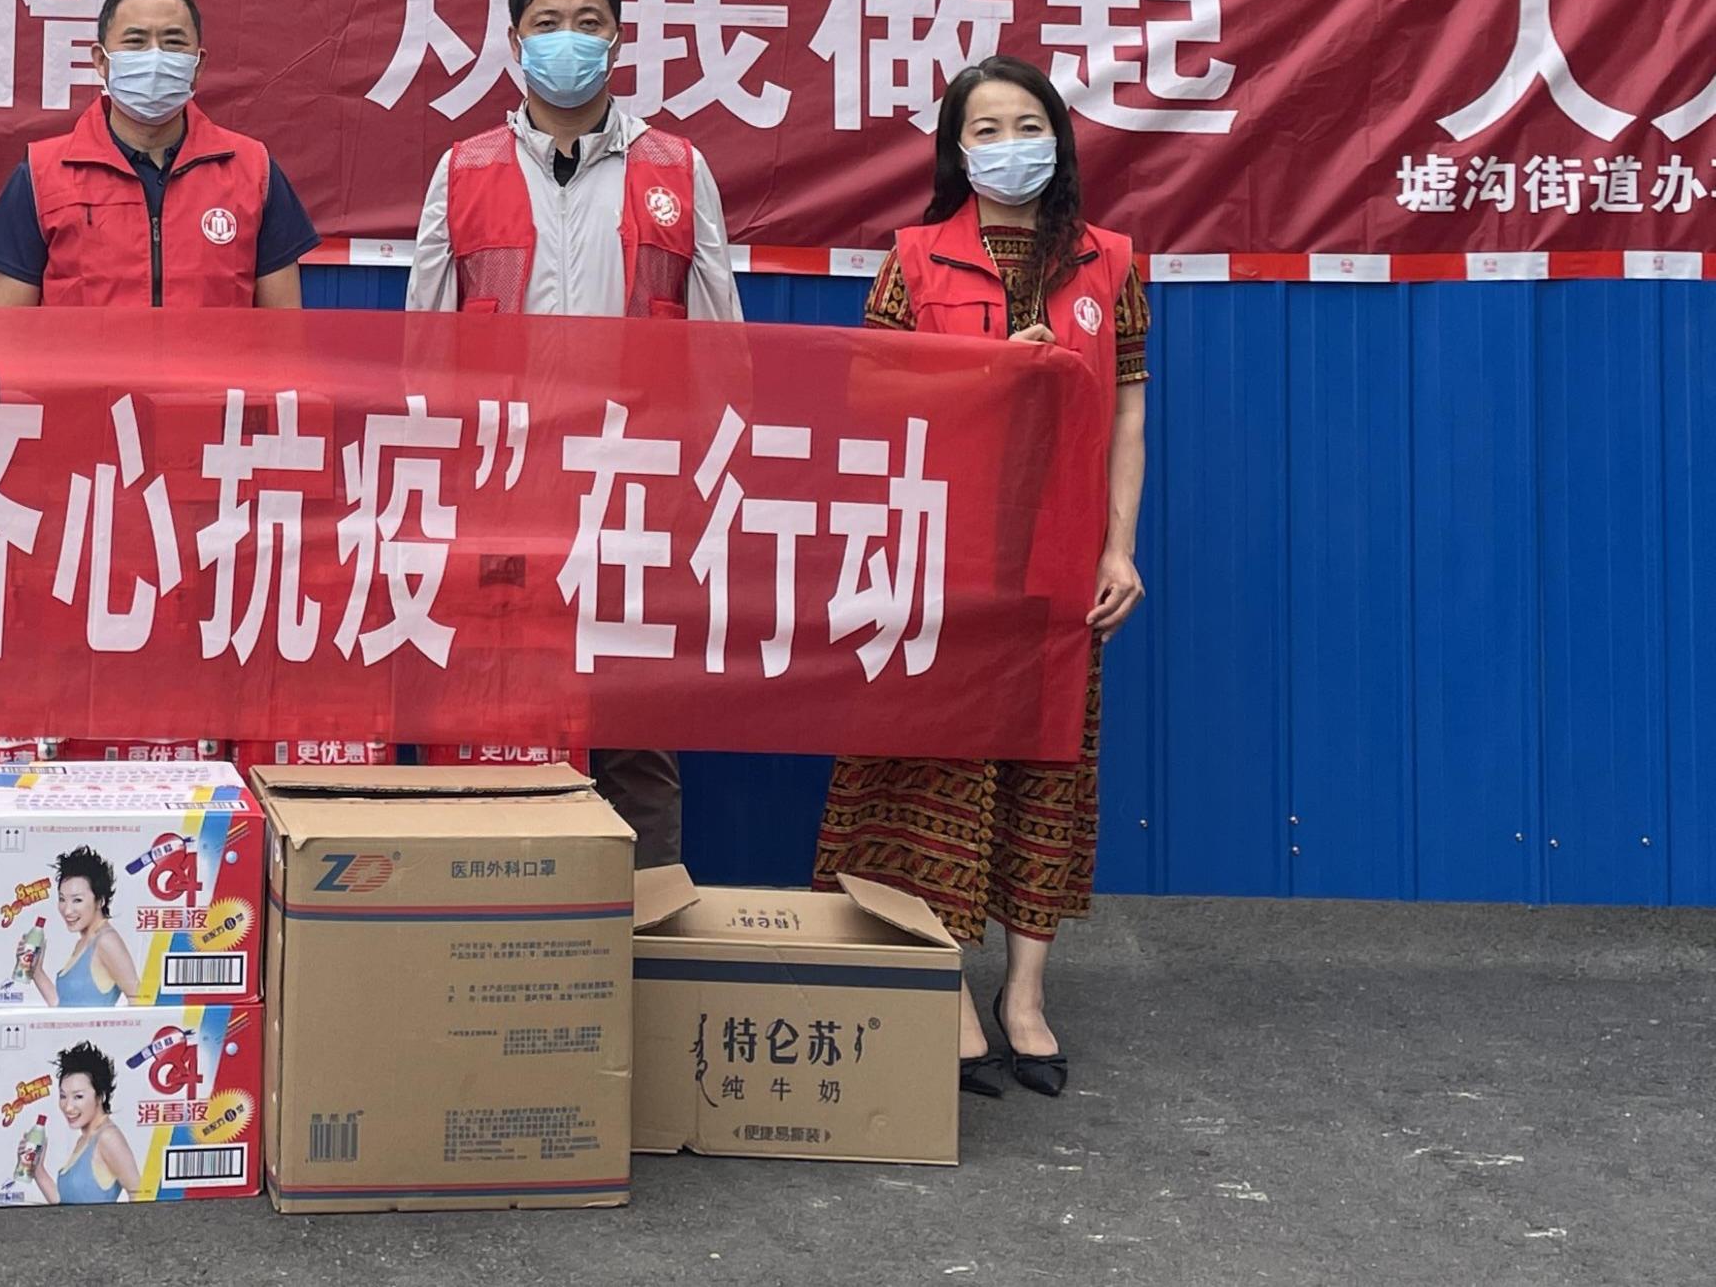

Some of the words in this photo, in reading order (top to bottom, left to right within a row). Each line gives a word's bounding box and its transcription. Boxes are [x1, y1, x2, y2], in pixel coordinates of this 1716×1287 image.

[1396, 154, 1716, 214] 墟沟街道办
[297, 741, 366, 764] 更优惠
[451, 859, 557, 879] 医用外科口罩
[136, 909, 208, 930] 消毒液
[723, 1016, 842, 1066] 特仑苏
[721, 1075, 842, 1104] 纯牛奶
[137, 1102, 209, 1123] 消毒液
